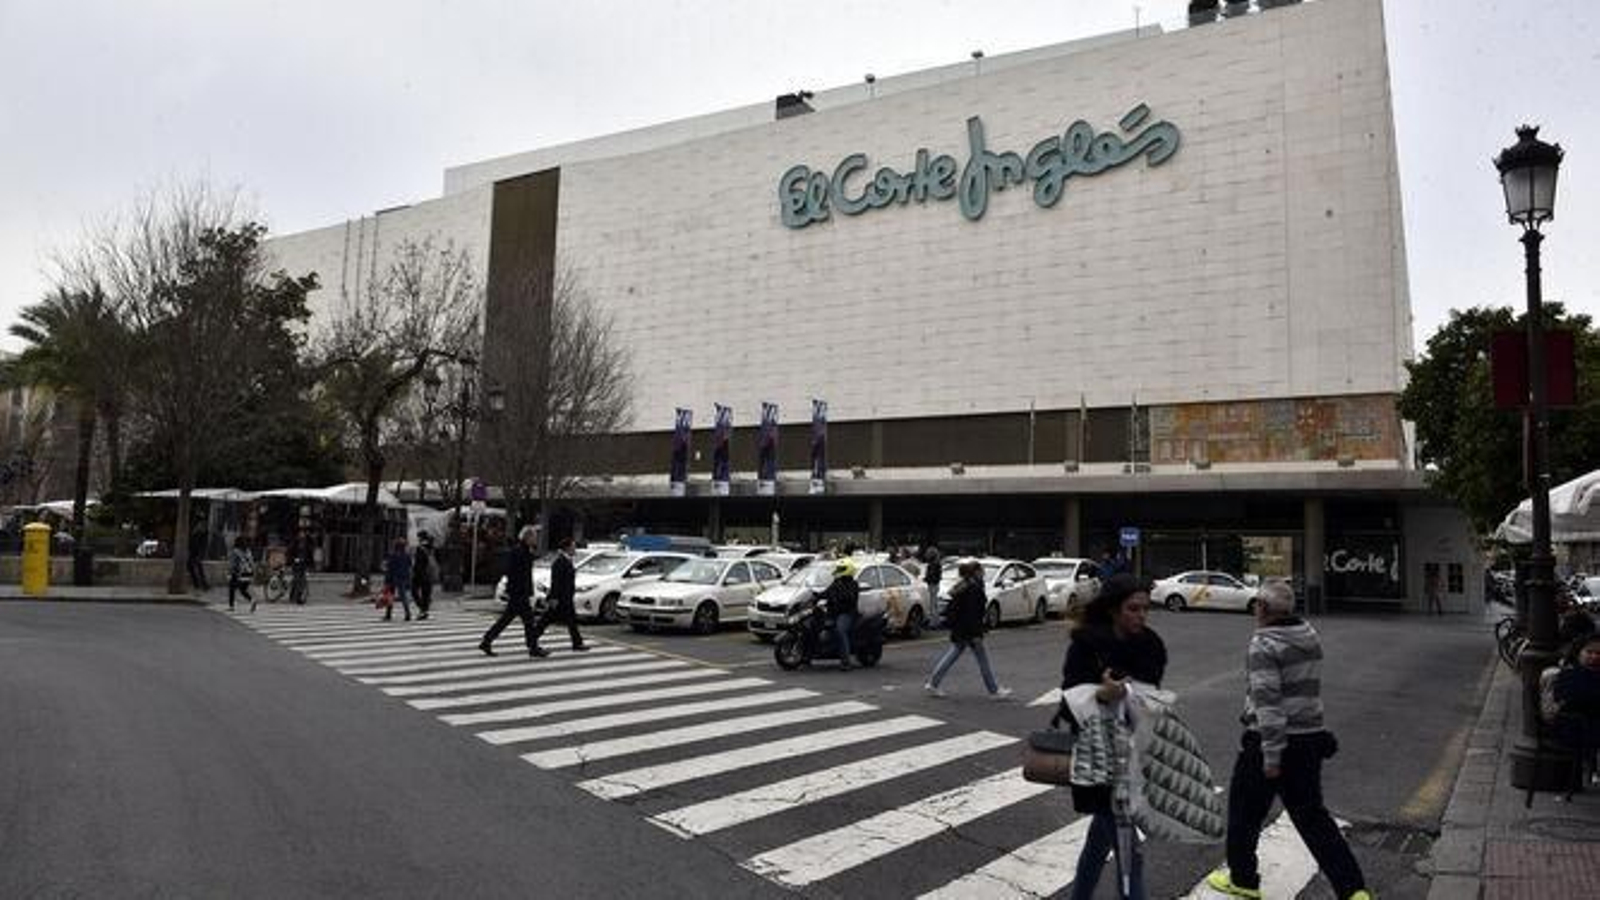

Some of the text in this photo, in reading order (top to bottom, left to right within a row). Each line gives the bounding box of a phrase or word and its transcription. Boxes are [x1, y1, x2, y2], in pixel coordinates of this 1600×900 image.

[779, 102, 1180, 228] El Corte Inglés
[1330, 549, 1387, 574] Corte
